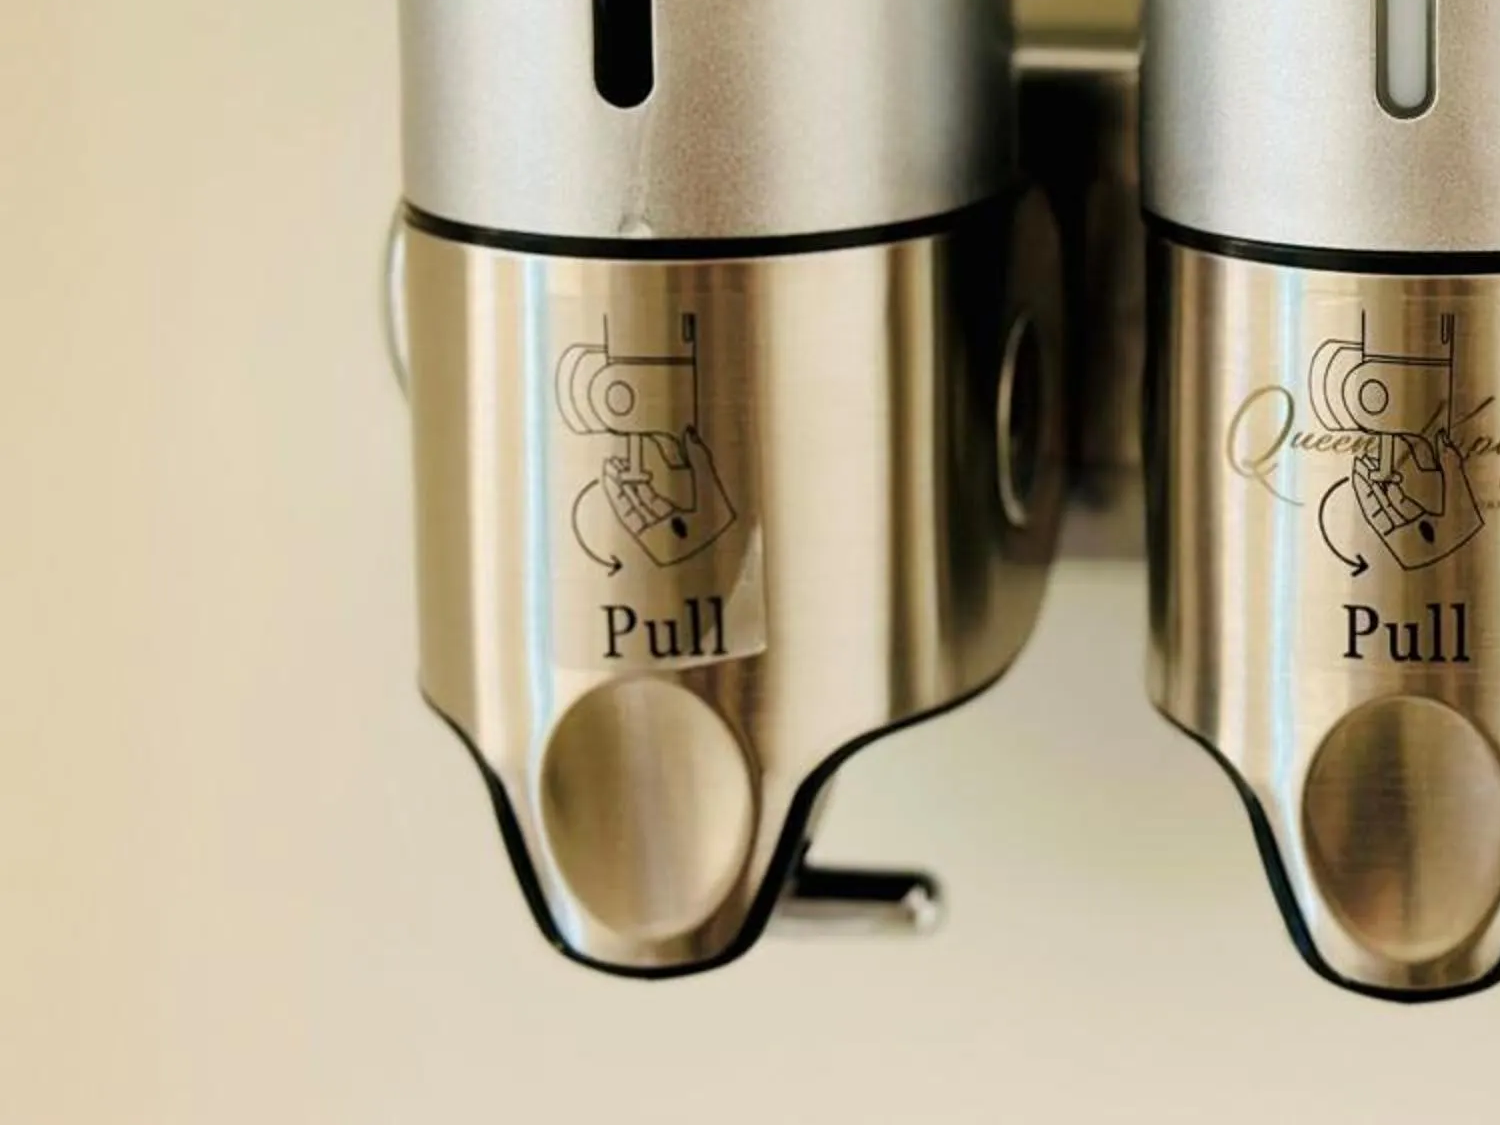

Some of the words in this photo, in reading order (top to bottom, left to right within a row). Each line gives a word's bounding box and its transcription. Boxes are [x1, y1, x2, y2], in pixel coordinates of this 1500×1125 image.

[1226, 384, 1379, 507] Queen
[600, 596, 729, 660] Pull
[1342, 603, 1471, 663] Pull
